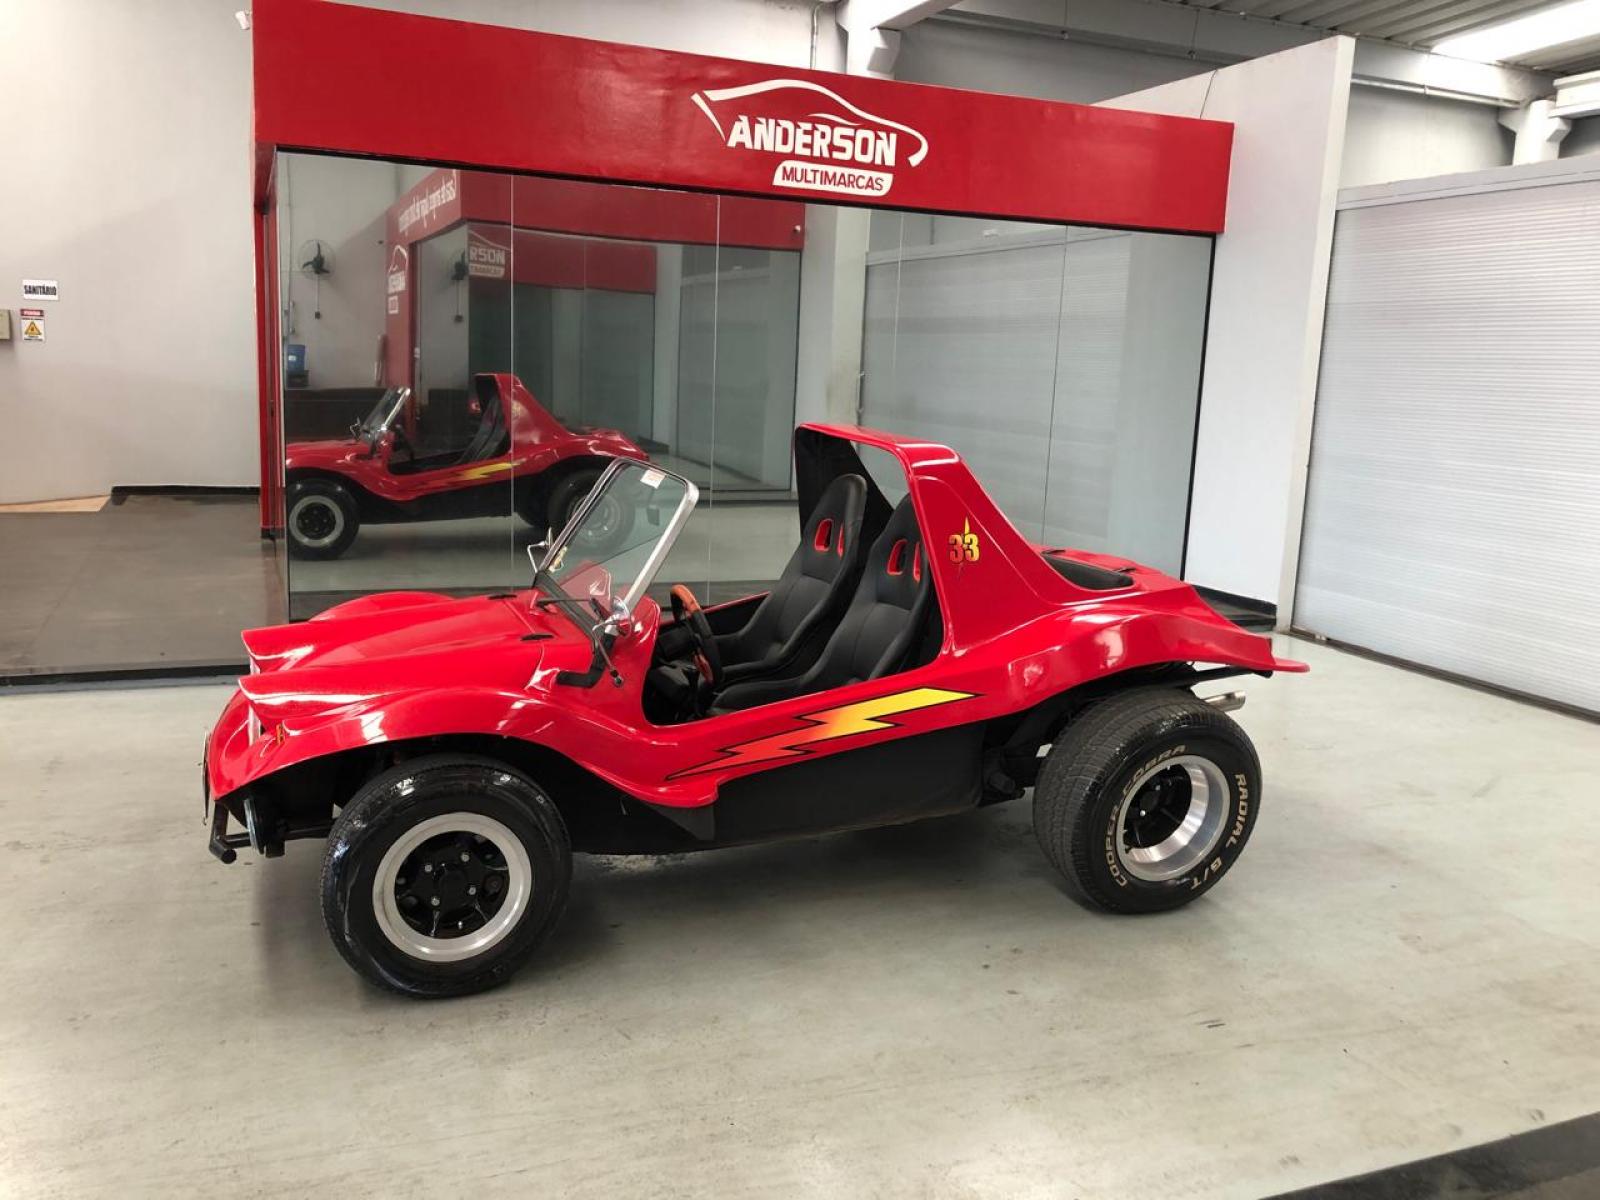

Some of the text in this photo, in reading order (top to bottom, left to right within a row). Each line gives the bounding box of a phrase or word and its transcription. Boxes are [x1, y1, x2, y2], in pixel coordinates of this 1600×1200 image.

[727, 115, 897, 166] ANDERSON
[781, 165, 884, 192] MULTIMARCAS
[24, 284, 57, 296] SANITÁRIO
[949, 533, 980, 562] 33
[1105, 745, 1186, 887] COOPER COBRA
[1225, 773, 1248, 848] RADIAL
